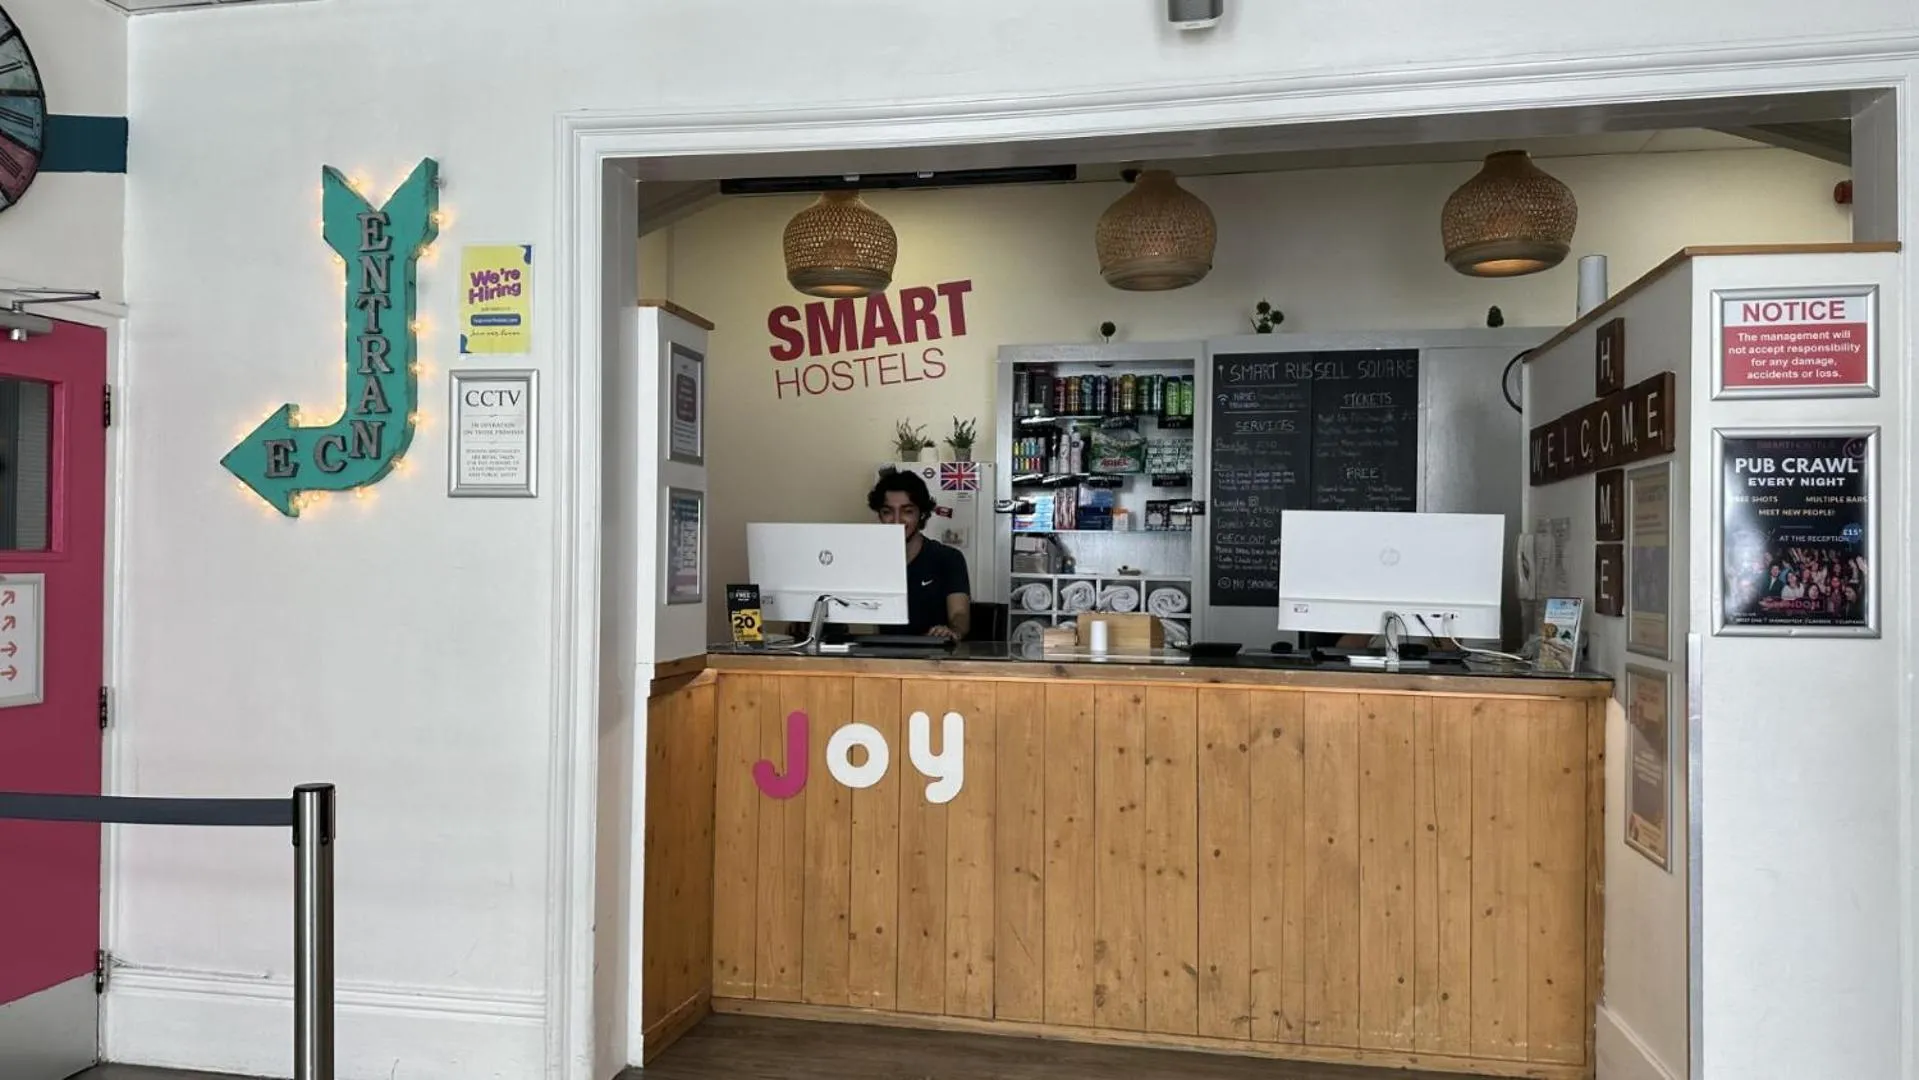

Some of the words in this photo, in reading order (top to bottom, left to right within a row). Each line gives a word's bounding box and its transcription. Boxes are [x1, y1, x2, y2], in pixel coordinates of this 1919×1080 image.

[470, 267, 521, 287] We're
[468, 282, 522, 305] Hiring
[767, 279, 972, 361] SMART
[1742, 300, 1846, 322] NOTICE
[263, 212, 394, 478] ENTRANCE
[1738, 332, 1758, 342] The
[1760, 330, 1830, 343] management
[1832, 330, 1851, 339] will
[1728, 346, 1746, 354] not
[1748, 345, 1785, 356] accept
[1786, 342, 1861, 355] responsibility
[1230, 363, 1279, 382] SMART
[1285, 361, 1350, 380] RUSSELL
[1358, 359, 1416, 379] SQUARE
[1751, 358, 1767, 367] for
[1768, 358, 1788, 368] any
[1791, 356, 1838, 368] damage,
[775, 347, 947, 399] HOSTELS
[1747, 370, 1799, 380] accidents
[1815, 369, 1842, 378] loss.
[464, 389, 521, 407] CCTV
[1531, 391, 1661, 474] WELCOME
[1735, 458, 1775, 473] PUB
[1781, 457, 1858, 473] CRAWL
[1748, 477, 1795, 487] EVERY
[1800, 477, 1846, 486] NIGHT
[1752, 495, 1778, 503] SHOTS
[734, 616, 755, 629] 20
